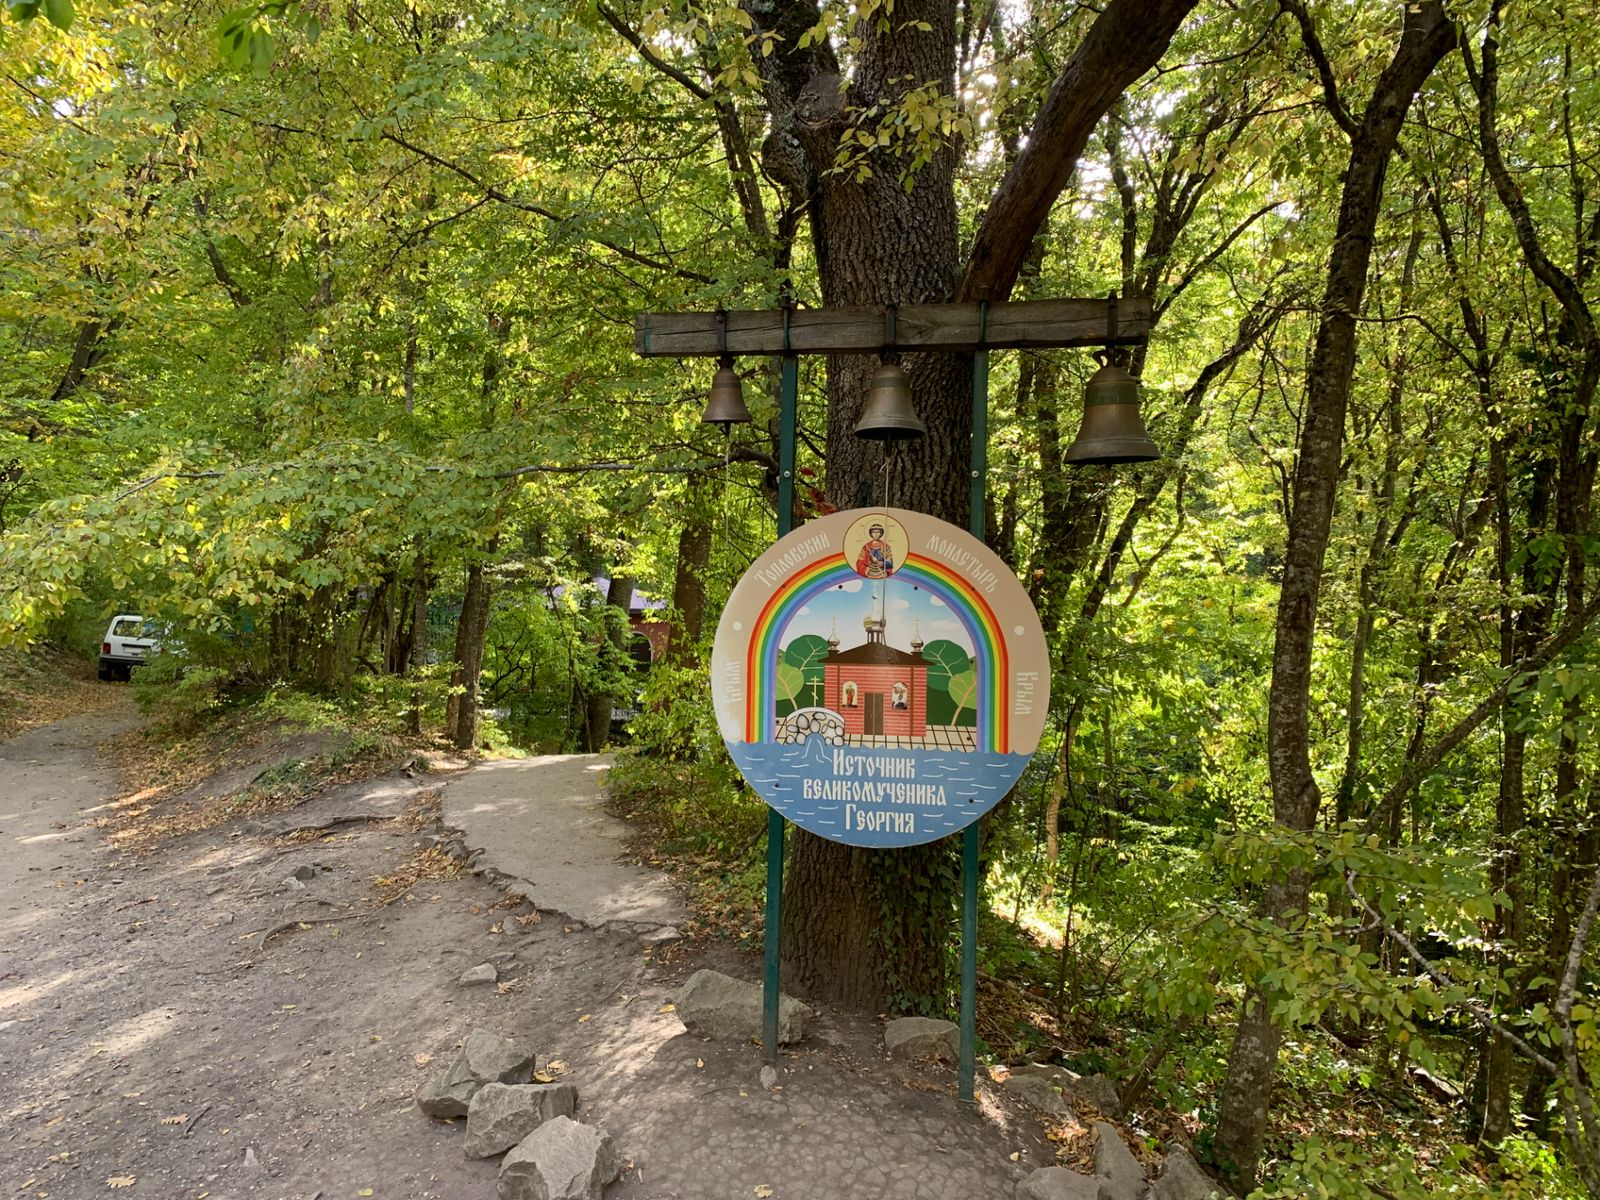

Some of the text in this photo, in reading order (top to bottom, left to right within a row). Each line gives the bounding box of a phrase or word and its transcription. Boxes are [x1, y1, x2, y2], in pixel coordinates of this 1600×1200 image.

[833, 748, 916, 779] Источник
[803, 778, 947, 807] великомученика
[845, 803, 915, 834] Георгия
